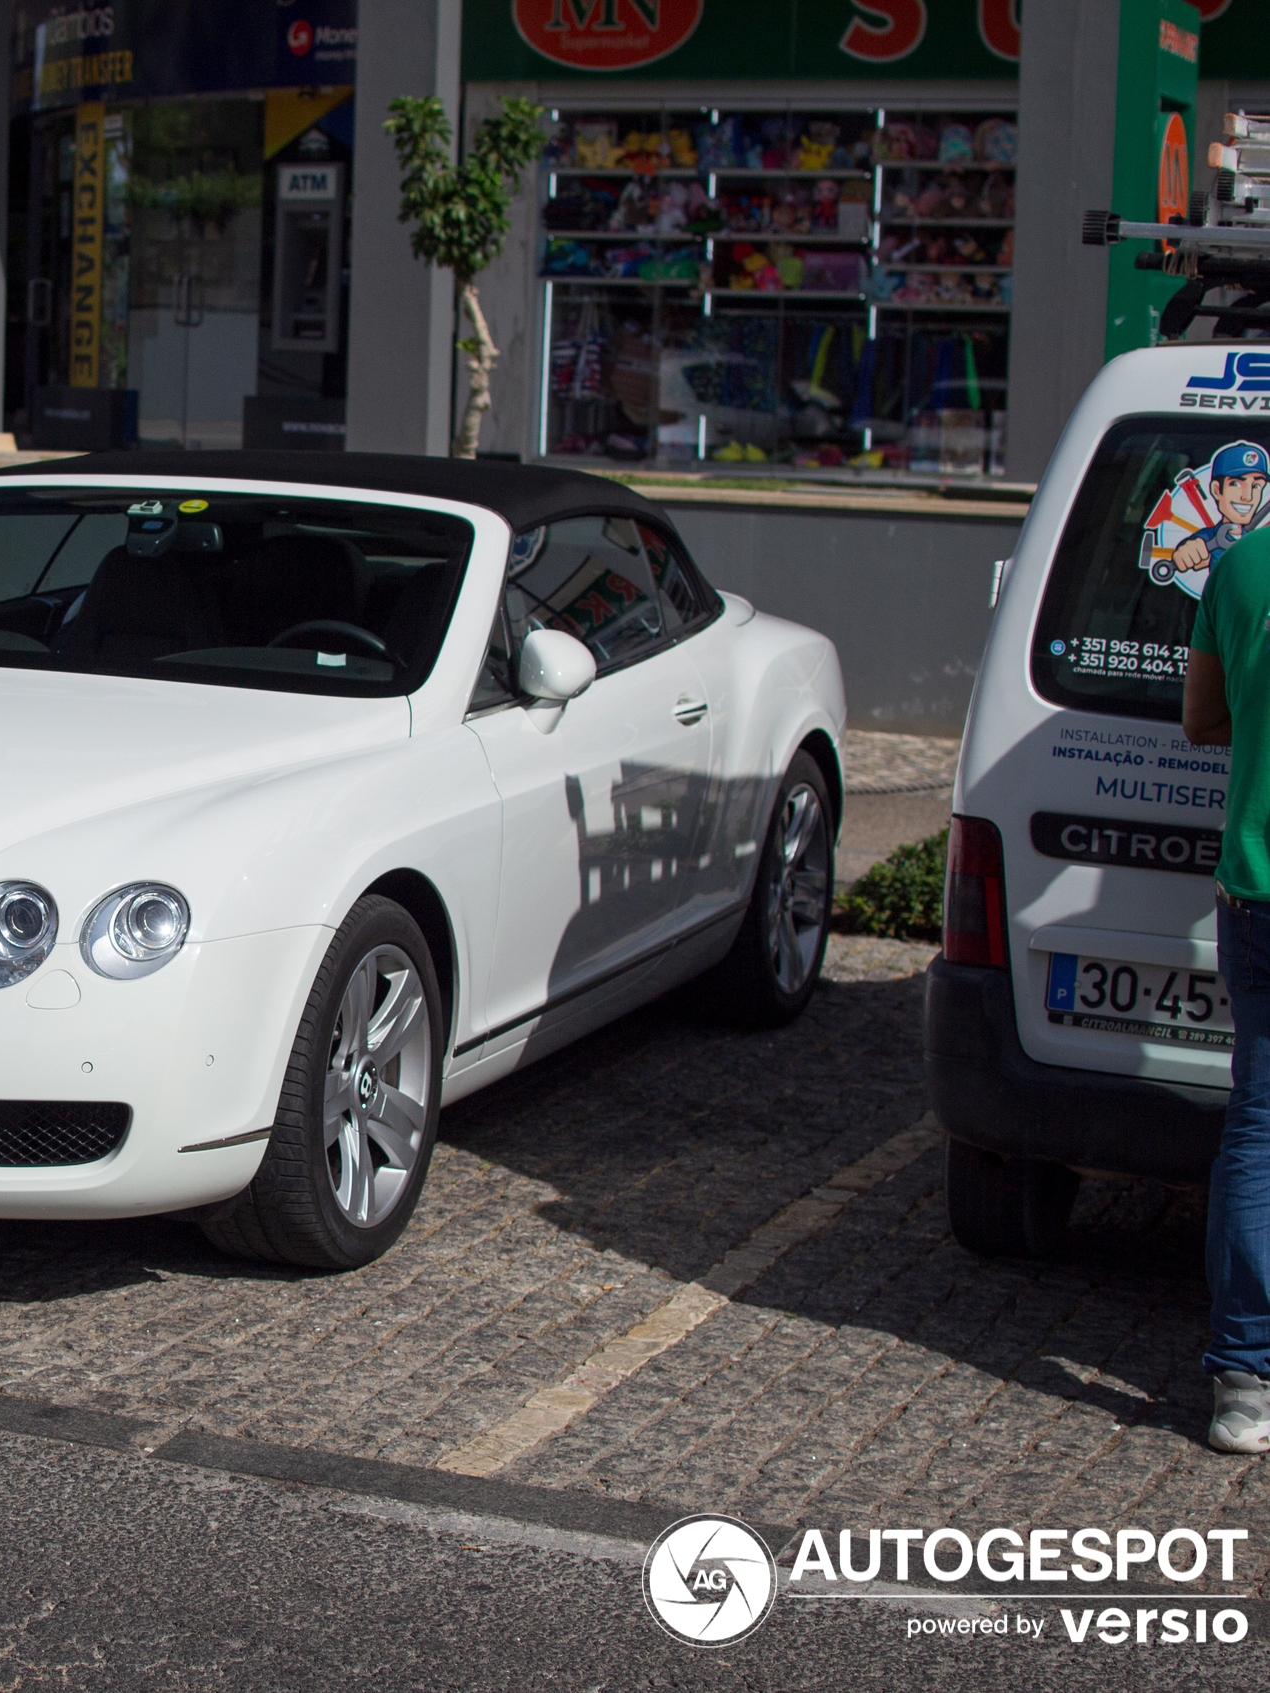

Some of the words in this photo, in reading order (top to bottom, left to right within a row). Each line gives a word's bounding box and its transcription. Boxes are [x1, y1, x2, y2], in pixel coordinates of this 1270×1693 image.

[289, 173, 327, 191] ATM
[73, 121, 98, 378] EXCHANGE
[1082, 637, 1107, 652] 351
[1109, 640, 1139, 655] 962
[1142, 643, 1170, 658] 614
[1173, 646, 1190, 660] 21
[1080, 652, 1105, 667] 351
[1108, 655, 1138, 670] 920
[1141, 659, 1174, 674] 404
[1073, 666, 1106, 676] chamada
[1107, 669, 1123, 677] para
[1125, 671, 1141, 679] rede
[1142, 673, 1165, 681] móvel
[1060, 728, 1158, 748] INSTALLATION
[1052, 746, 1144, 767] INSTALAÇÃO
[1158, 757, 1229, 775] REMODEL
[1096, 776, 1226, 810] MULTISER
[1057, 988, 1067, 1000] P
[1081, 1018, 1172, 1038] CITROALMANCIL
[1188, 1031, 1205, 1042] 289
[1207, 1034, 1223, 1044] 397
